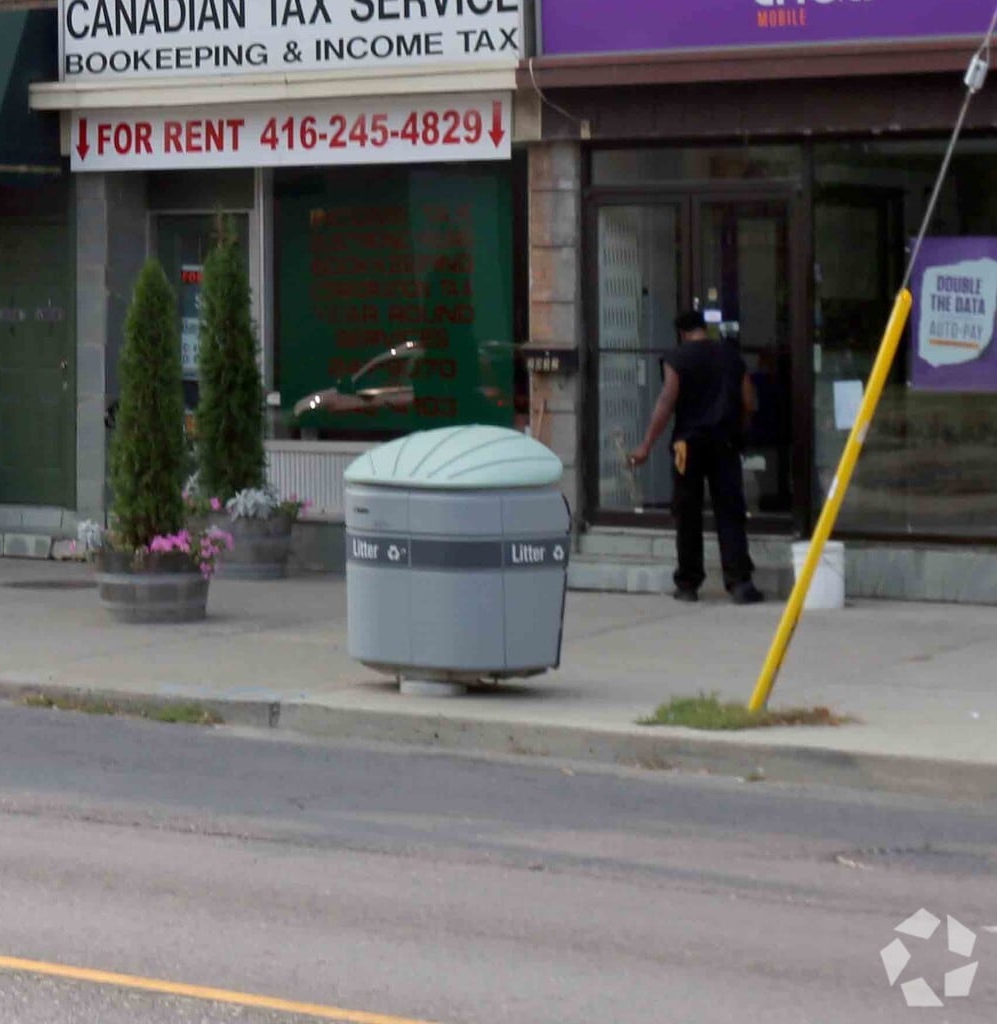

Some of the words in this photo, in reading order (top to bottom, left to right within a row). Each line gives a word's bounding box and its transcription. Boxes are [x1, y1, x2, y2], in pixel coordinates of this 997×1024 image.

[757, 8, 807, 27] MOBILE
[65, 42, 269, 75] BOOKEEPING
[282, 40, 304, 64] &
[315, 31, 444, 62] INCOME
[456, 27, 520, 54] TAX
[97, 122, 152, 156] FOR
[163, 118, 245, 153] RENT
[260, 109, 483, 151] 416-245-4829
[936, 275, 983, 295] DOUBLE
[930, 294, 952, 313] THE
[955, 297, 986, 316] DATA
[352, 539, 379, 559] Litter
[511, 543, 545, 564] Litter
